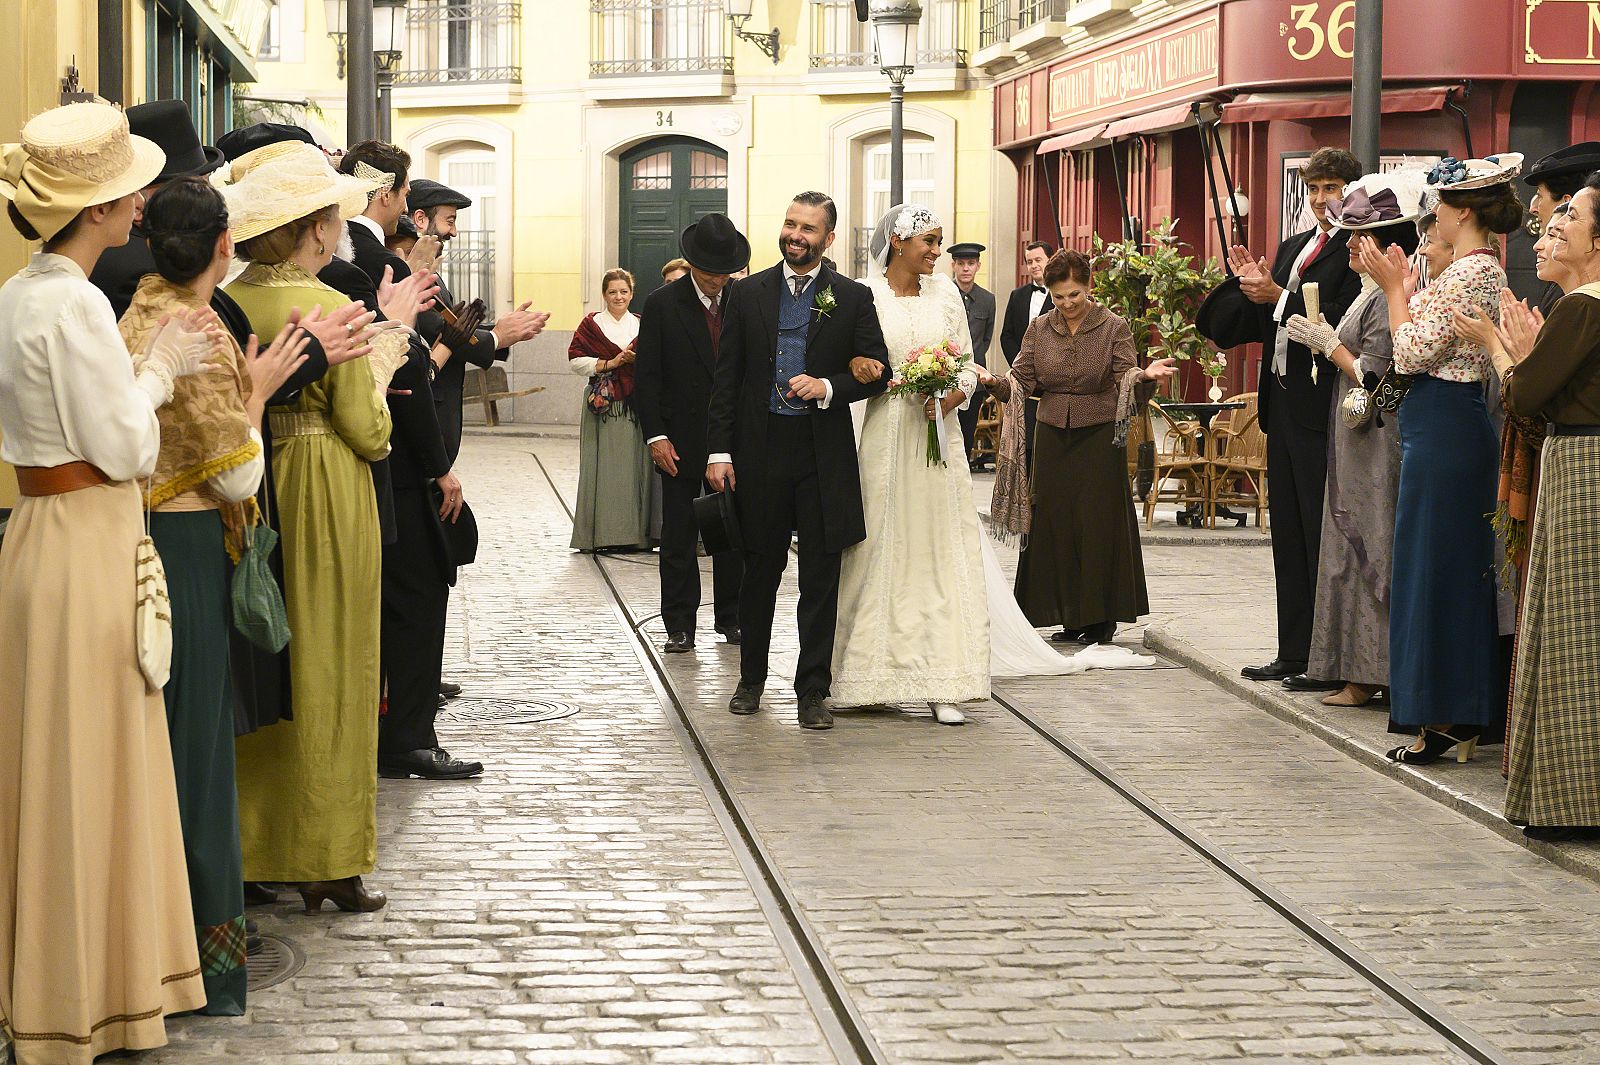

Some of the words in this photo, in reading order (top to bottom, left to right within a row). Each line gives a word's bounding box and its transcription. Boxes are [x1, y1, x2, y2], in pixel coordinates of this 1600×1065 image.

[1287, 1, 1355, 60] 36
[1053, 68, 1090, 113] RESTAURANTE
[1165, 25, 1217, 82] RESTAURANTE
[656, 110, 673, 127] 34
[1015, 84, 1029, 128] 36
